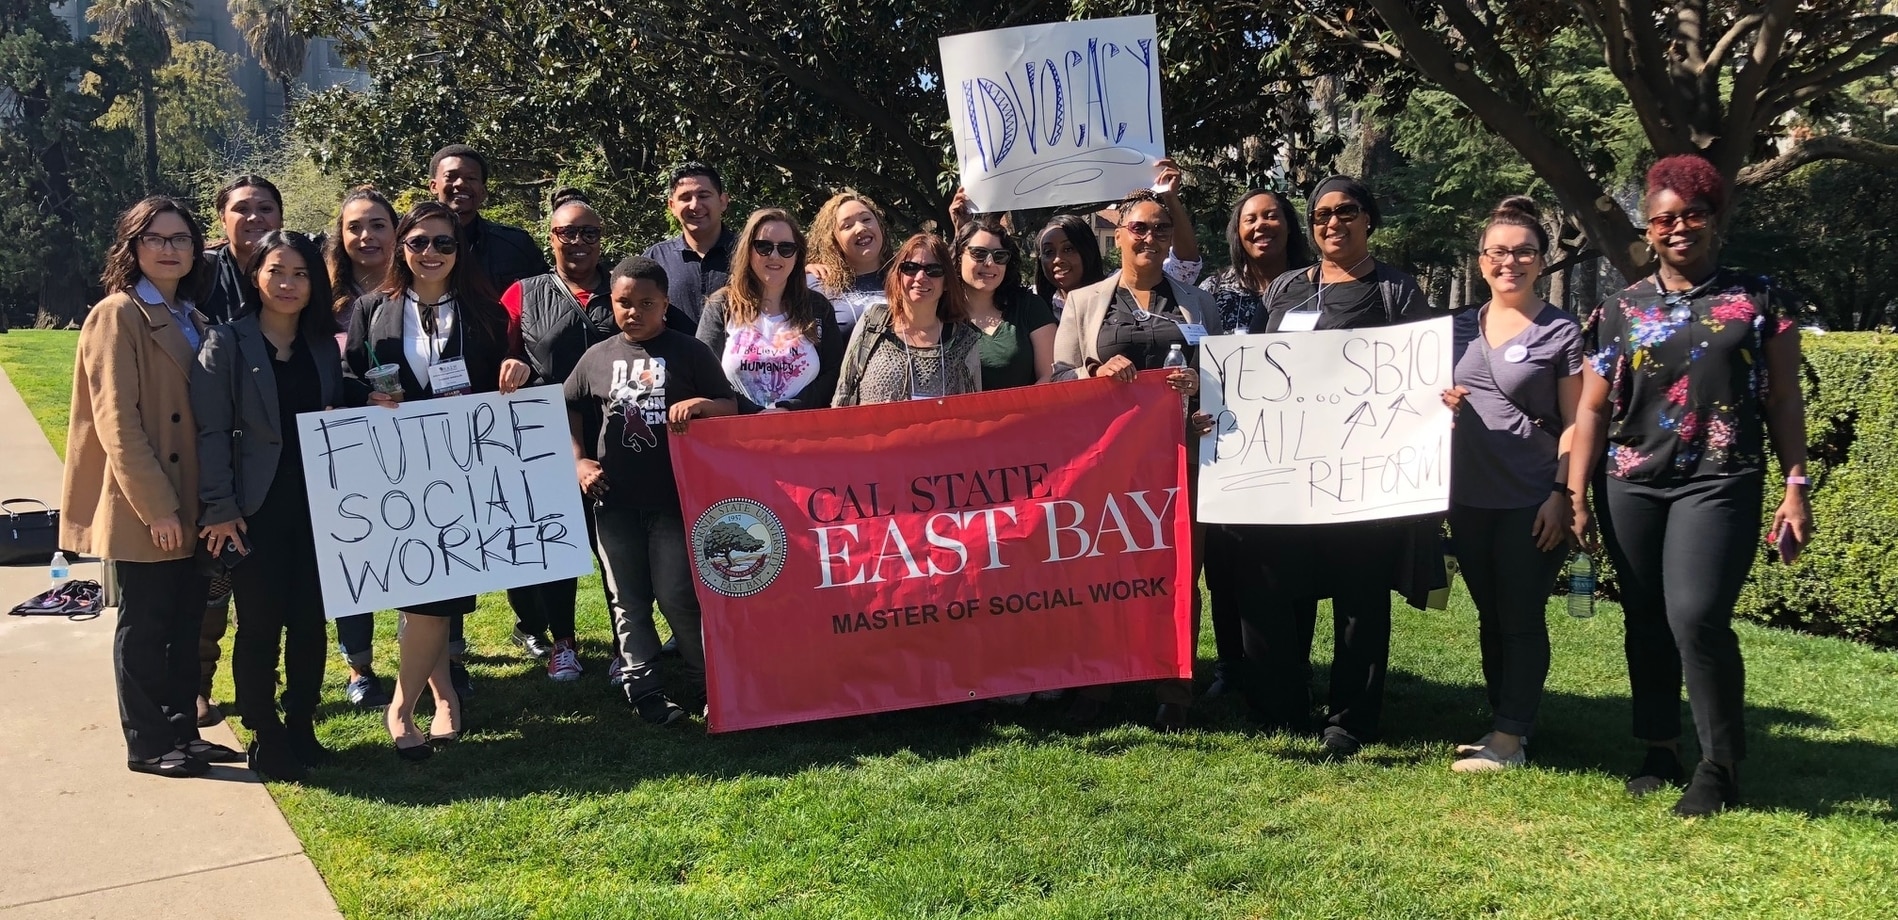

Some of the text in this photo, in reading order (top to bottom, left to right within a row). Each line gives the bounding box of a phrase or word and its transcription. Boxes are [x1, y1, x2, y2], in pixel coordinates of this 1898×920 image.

[962, 38, 1153, 174] ADVOCACY
[789, 346, 799, 356] IN
[1343, 329, 1441, 397] SB10
[314, 398, 556, 490] FUTURE
[1214, 408, 1327, 465] BAIL
[1308, 434, 1443, 508] REFORM
[330, 465, 565, 543] SOCIAL
[727, 514, 742, 523] 1957
[807, 463, 1053, 524] CAL STATE
[338, 521, 578, 604] WORKER
[695, 502, 783, 577] CALIFORNIA STATE UNIVERSITY
[808, 487, 1181, 590] EAST BAY
[720, 577, 766, 592] EAST BAY
[832, 576, 1168, 634] MASTER OF SOCIAL WORK
